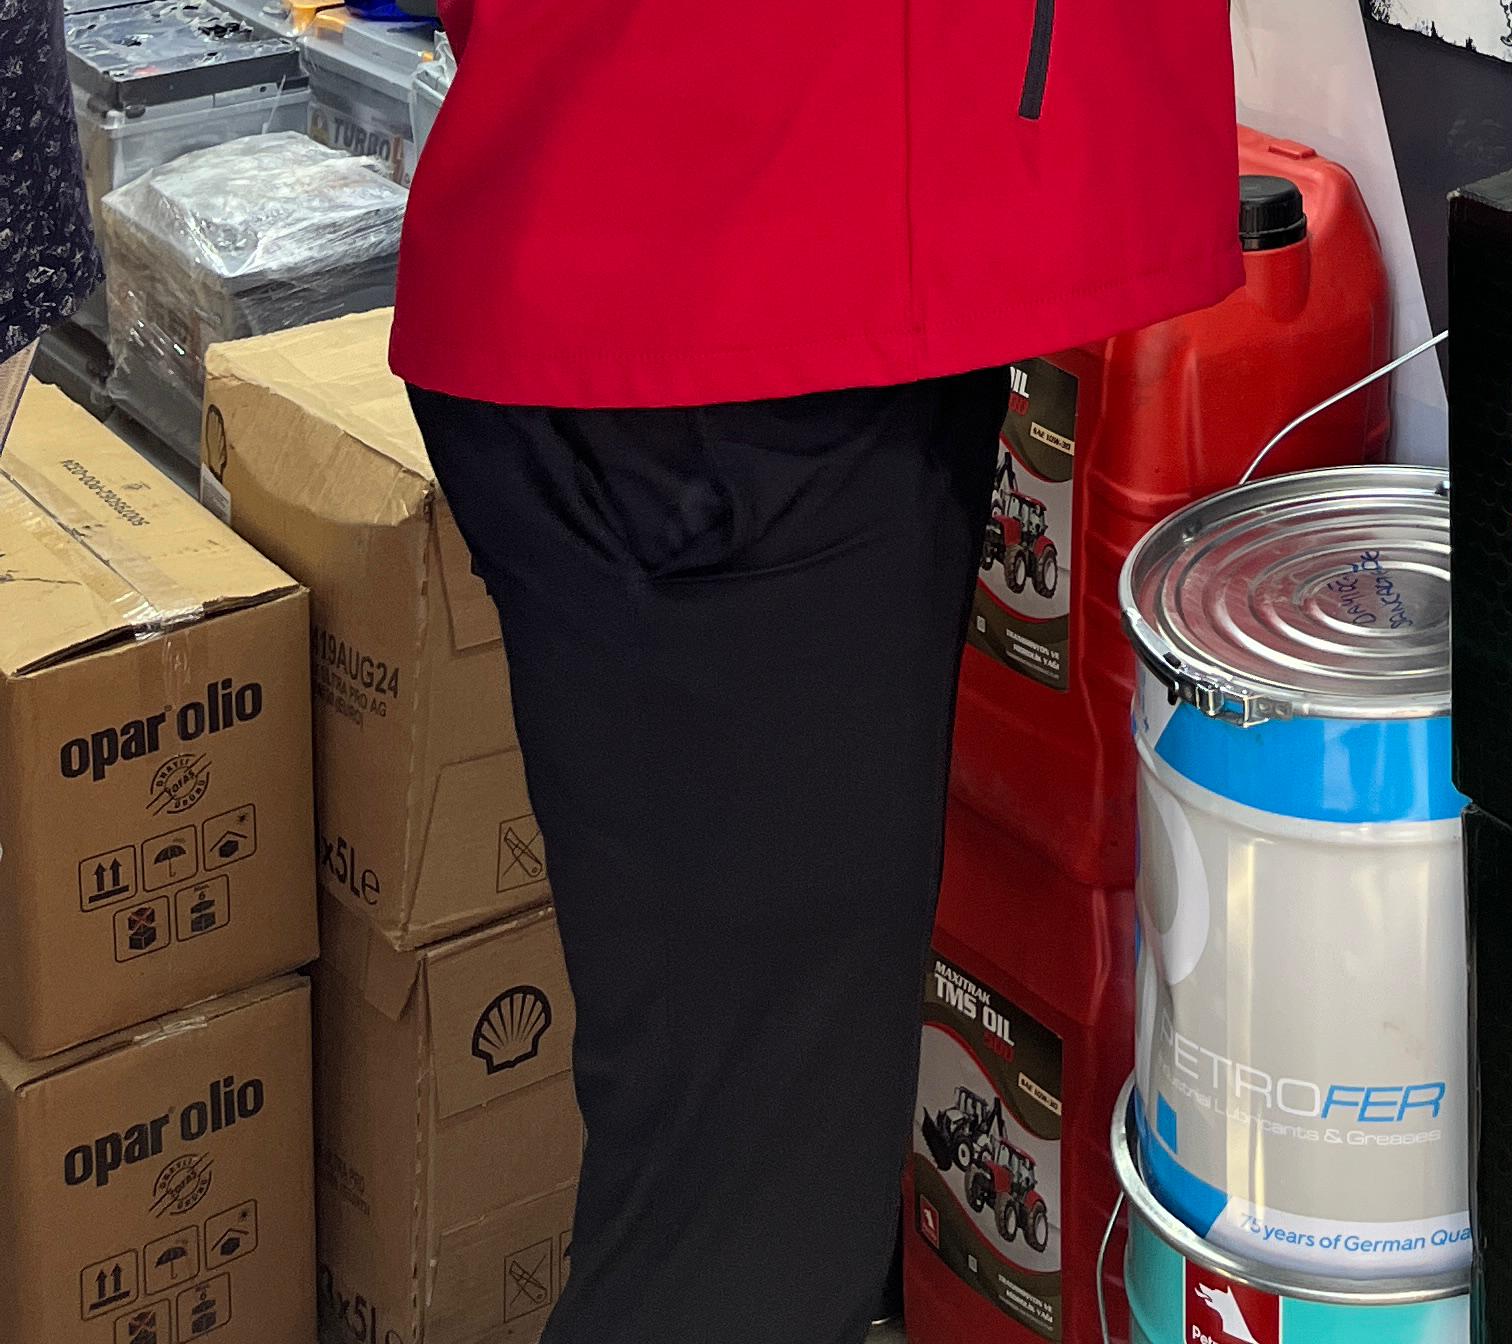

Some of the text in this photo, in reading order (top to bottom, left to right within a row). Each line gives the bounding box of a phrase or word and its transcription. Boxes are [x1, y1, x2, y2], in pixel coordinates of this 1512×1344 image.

[60, 709, 167, 783] opar
[176, 677, 263, 743] olio
[934, 973, 977, 1020] TMS
[982, 1004, 1015, 1048] OIL
[935, 960, 991, 1006] MAXITRAK
[64, 1114, 170, 1187] opar
[180, 1075, 265, 1142] olio
[1324, 1127, 1344, 1145] &
[1263, 1222, 1316, 1248] years
[1320, 1229, 1343, 1250] of
[1345, 1233, 1426, 1254] German
